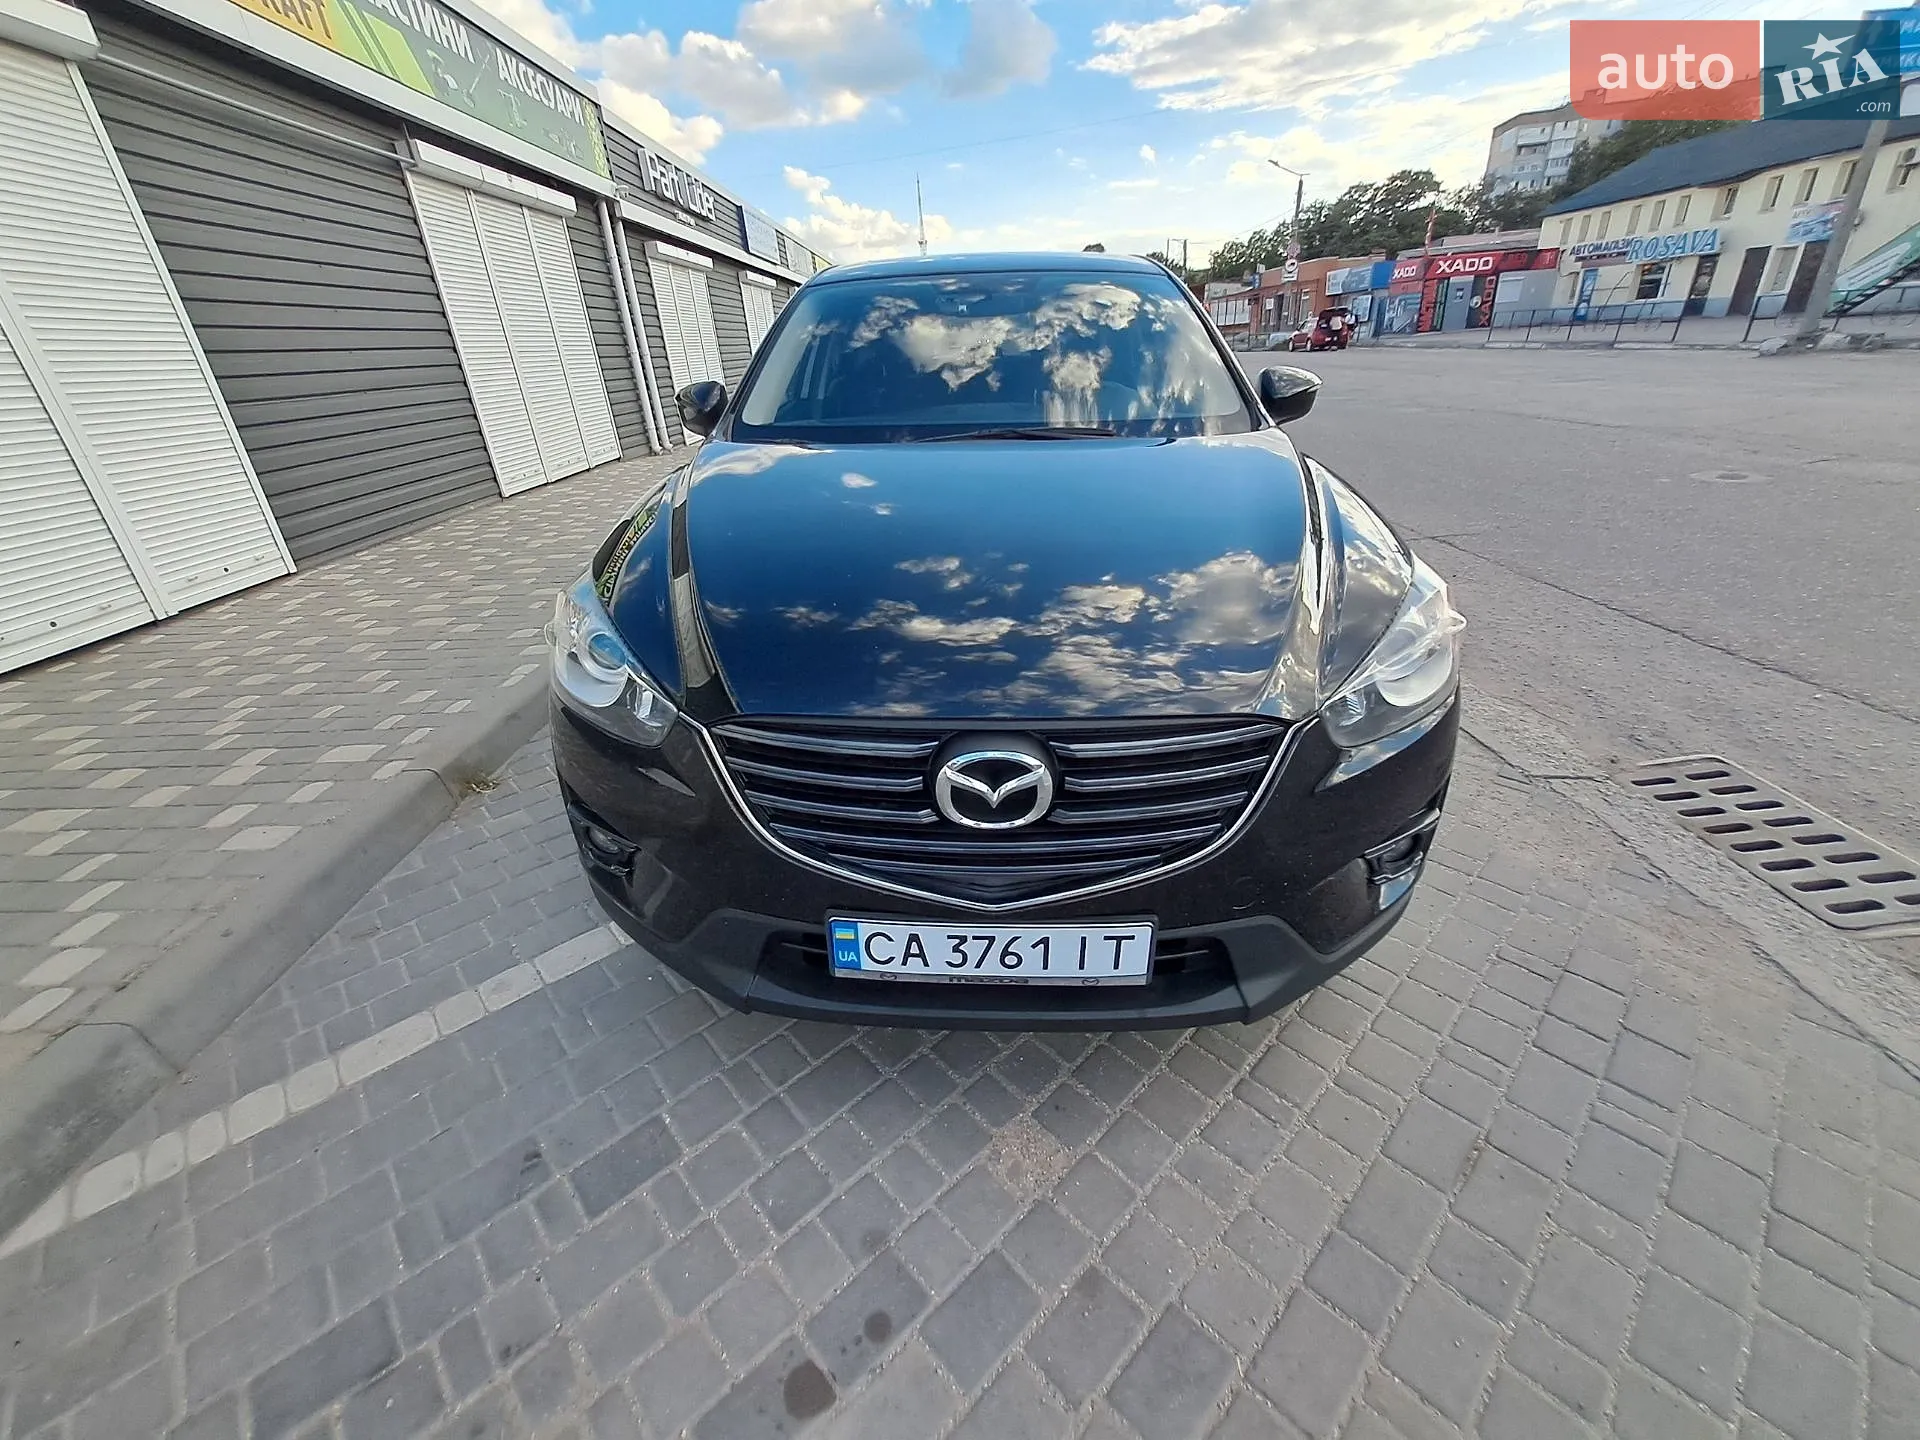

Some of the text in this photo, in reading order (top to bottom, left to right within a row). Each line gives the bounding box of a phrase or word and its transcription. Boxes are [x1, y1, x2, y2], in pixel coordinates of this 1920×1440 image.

[495, 47, 585, 126] АКСЕСУАРИ
[641, 148, 684, 206] Part
[1626, 227, 1720, 262] ROSAVA
[1392, 265, 1417, 279] XADO
[1436, 256, 1493, 274] XADO
[1478, 275, 1497, 327] XADO
[838, 950, 858, 963] UA
[863, 931, 1136, 971] CA 3761 IT
